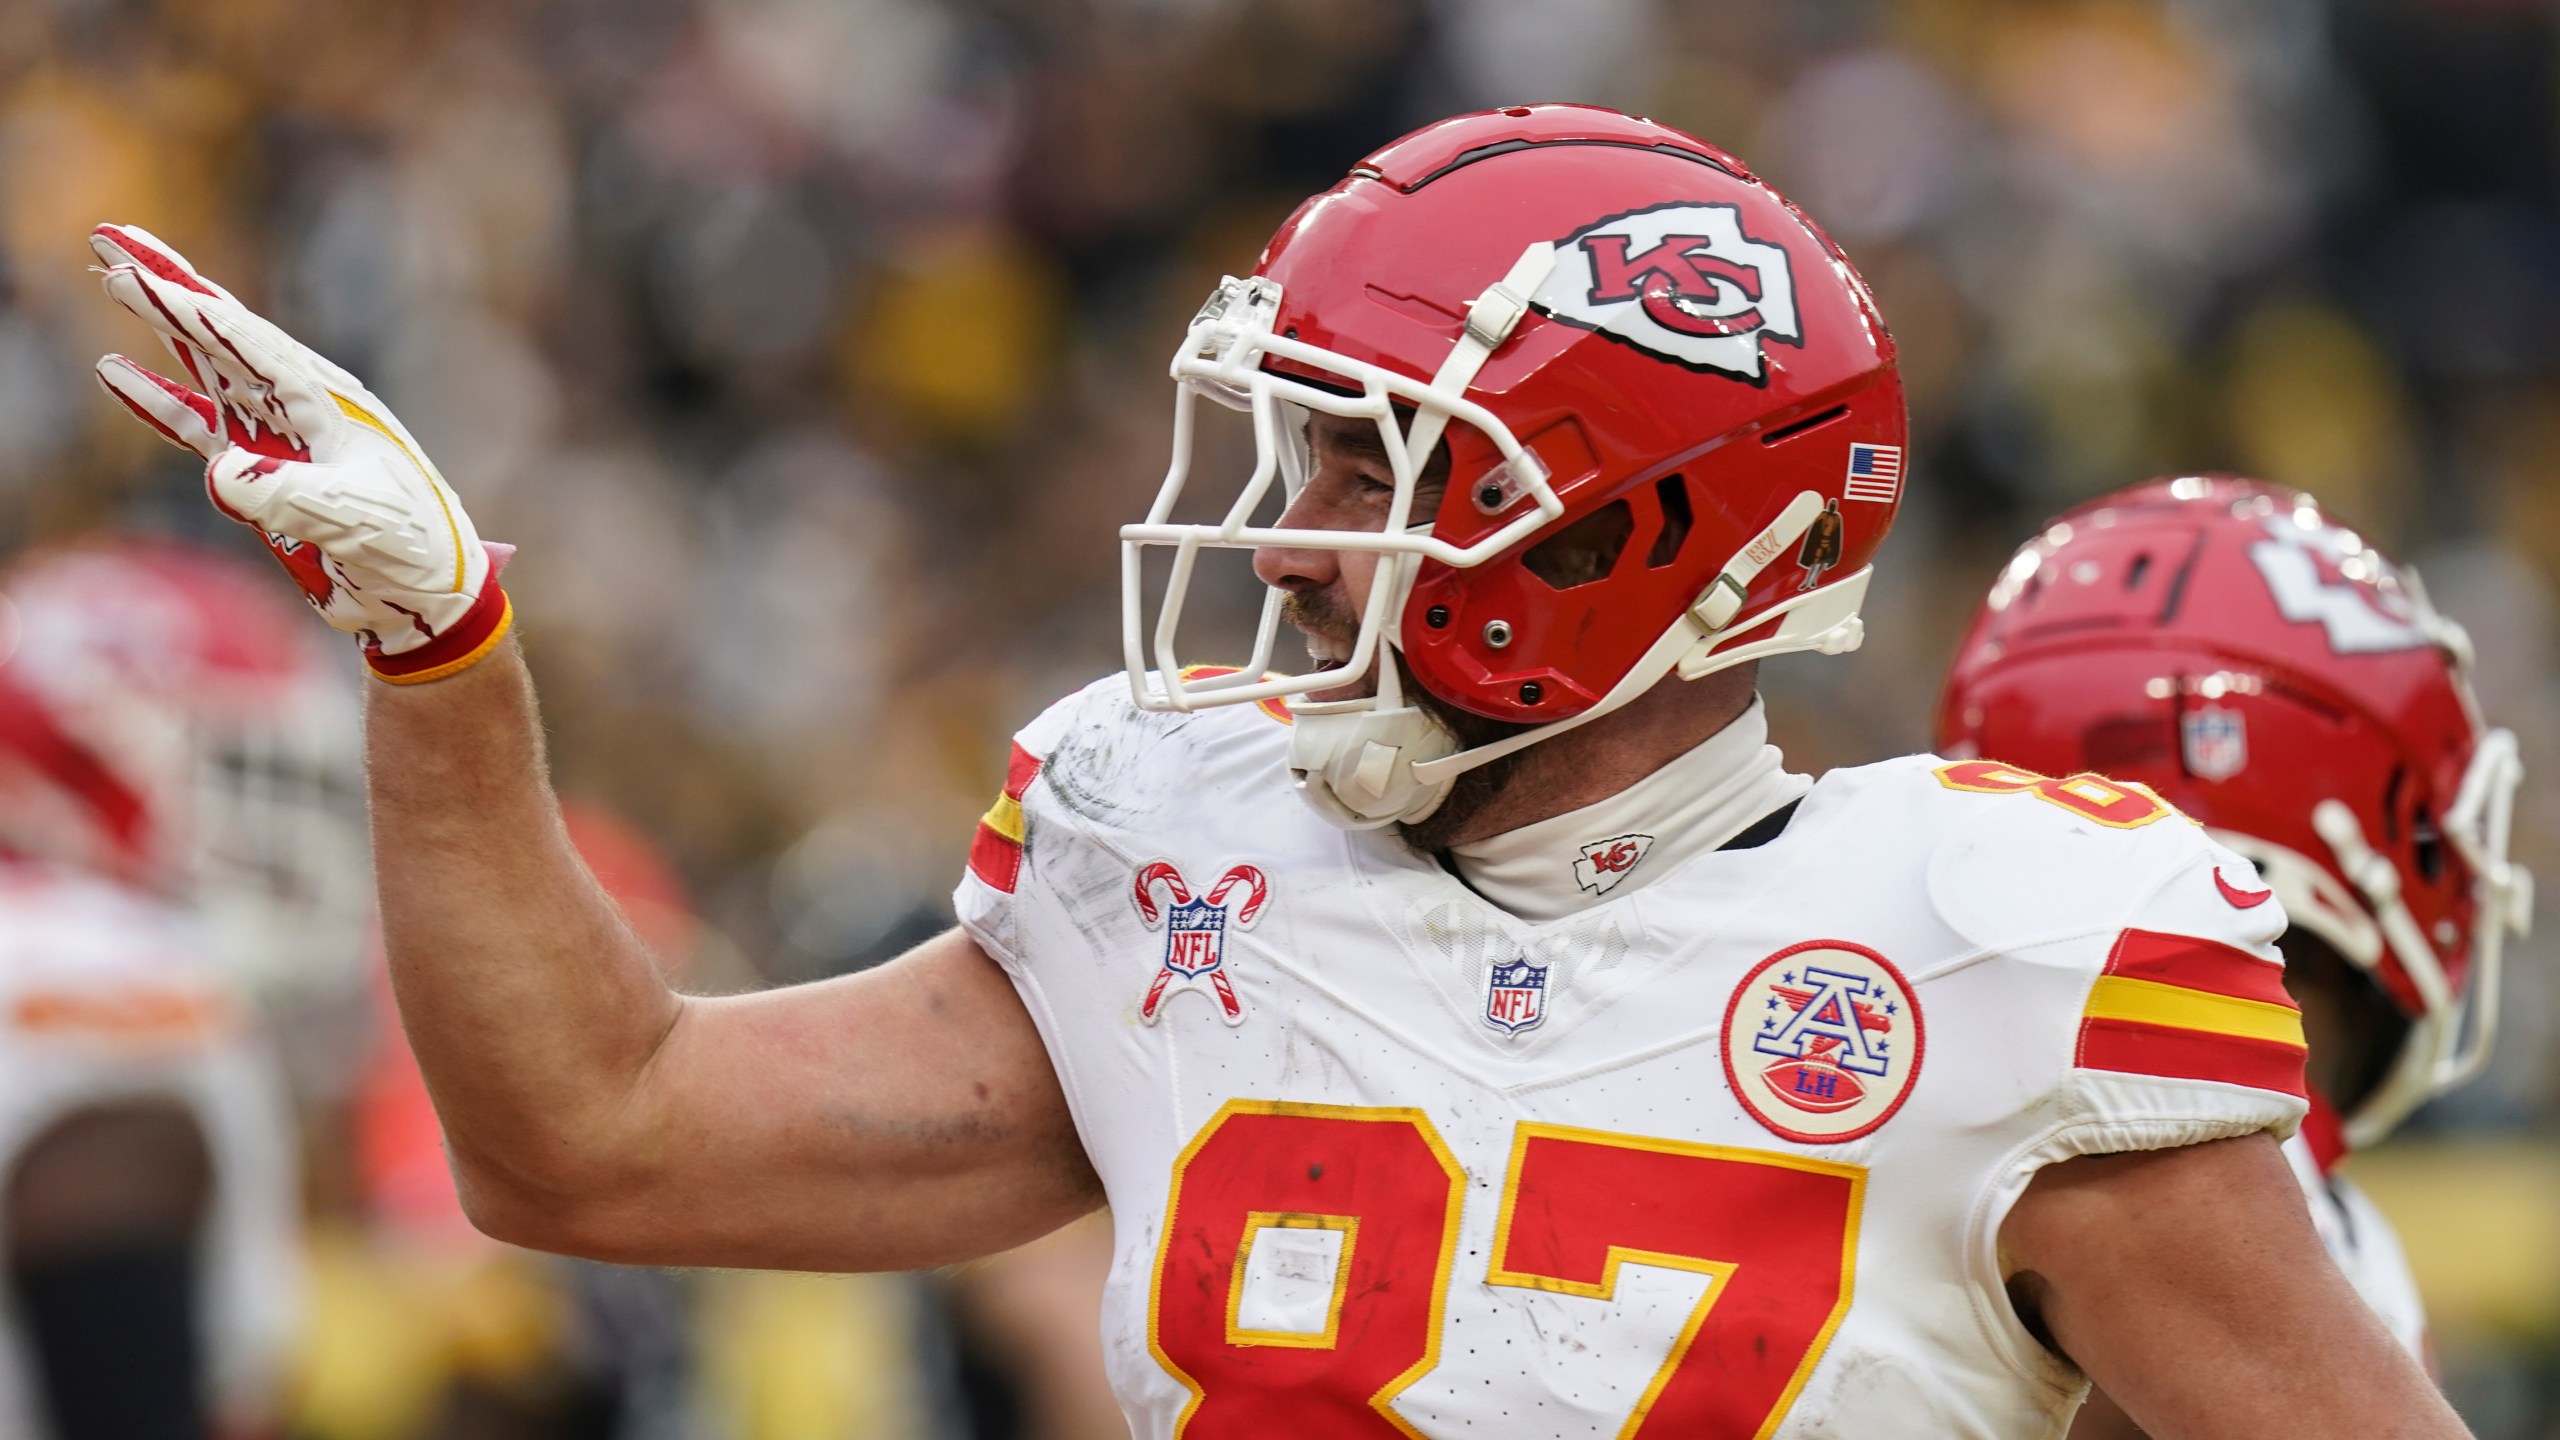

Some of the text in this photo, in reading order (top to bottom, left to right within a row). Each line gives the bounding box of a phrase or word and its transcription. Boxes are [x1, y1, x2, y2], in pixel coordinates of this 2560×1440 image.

[1579, 233, 1766, 338] KC
[1590, 841, 1639, 874] KC
[1169, 932, 1217, 970] NFL
[1490, 988, 1536, 1023] NFL
[1794, 1069, 1838, 1099] LH
[1148, 1098, 1869, 1440] 87
